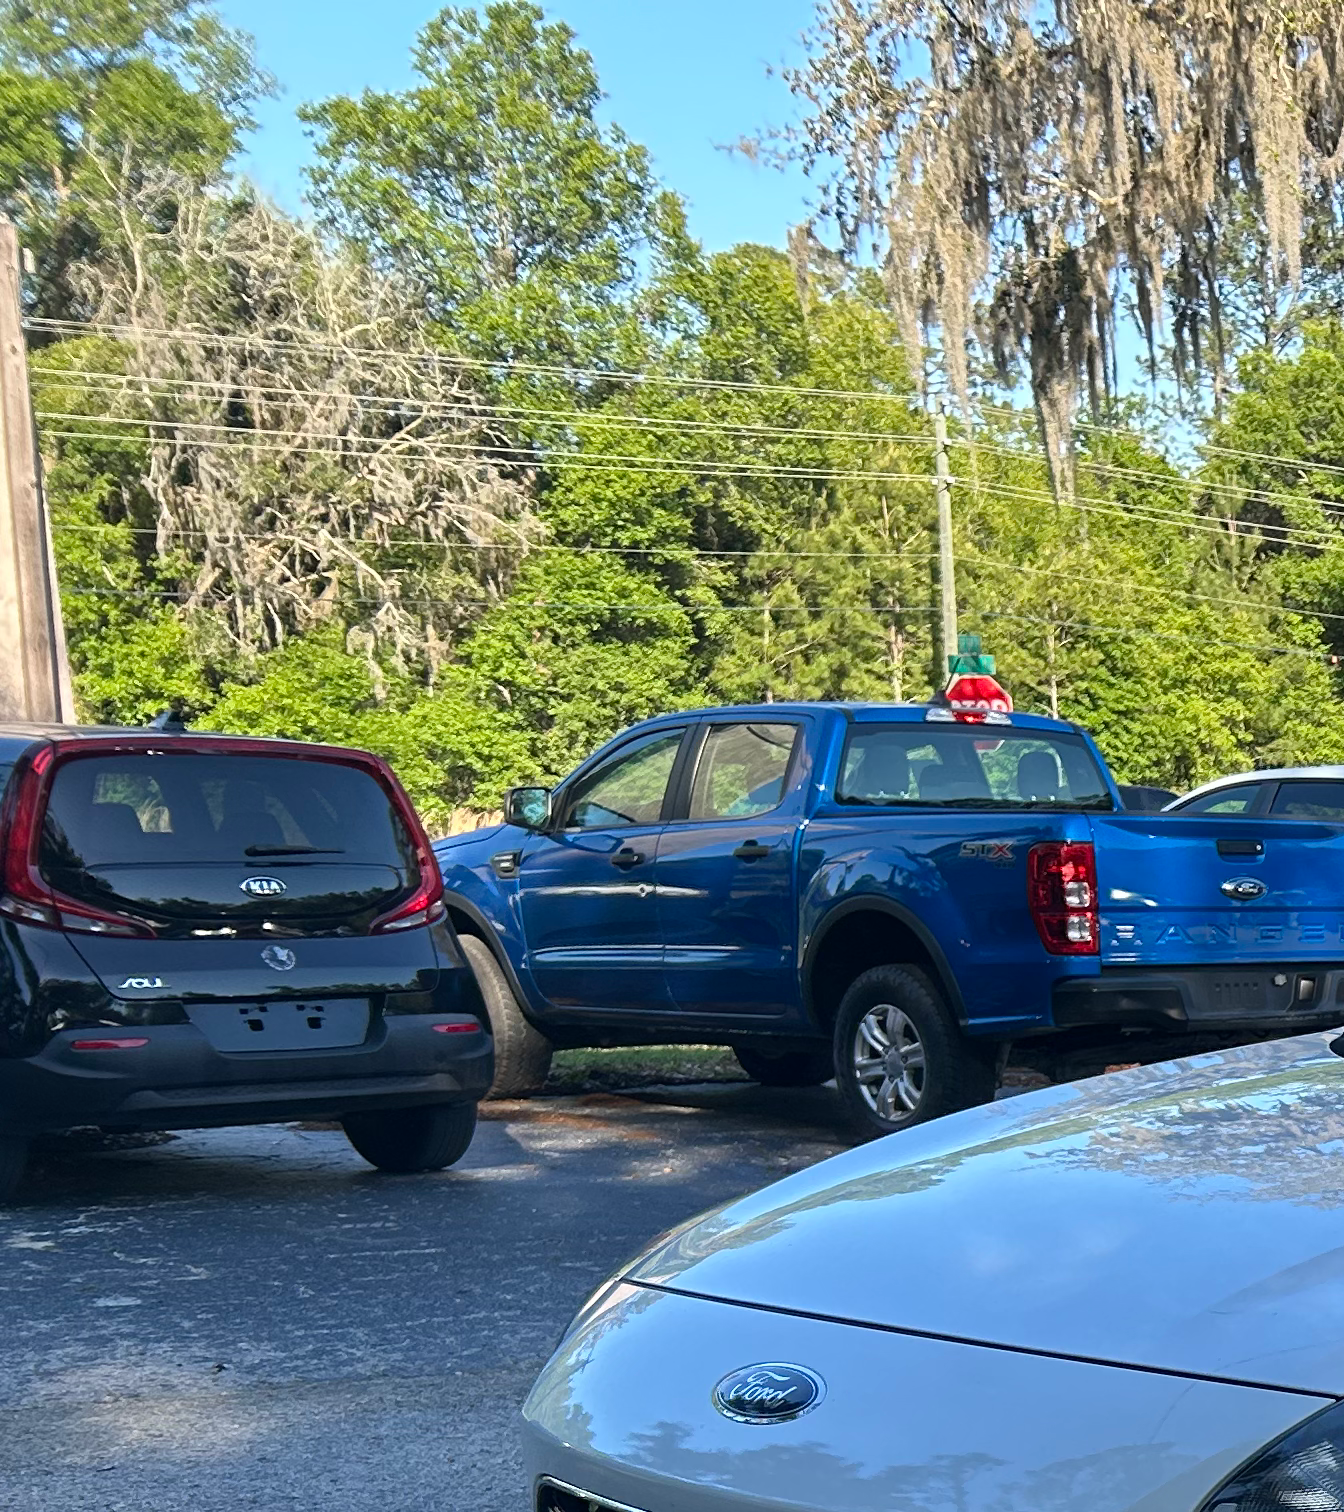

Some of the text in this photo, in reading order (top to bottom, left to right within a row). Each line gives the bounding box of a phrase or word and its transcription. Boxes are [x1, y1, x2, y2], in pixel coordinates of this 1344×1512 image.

[960, 840, 1015, 859] STX
[249, 880, 281, 894] KIA
[729, 1370, 798, 1410] Ford
